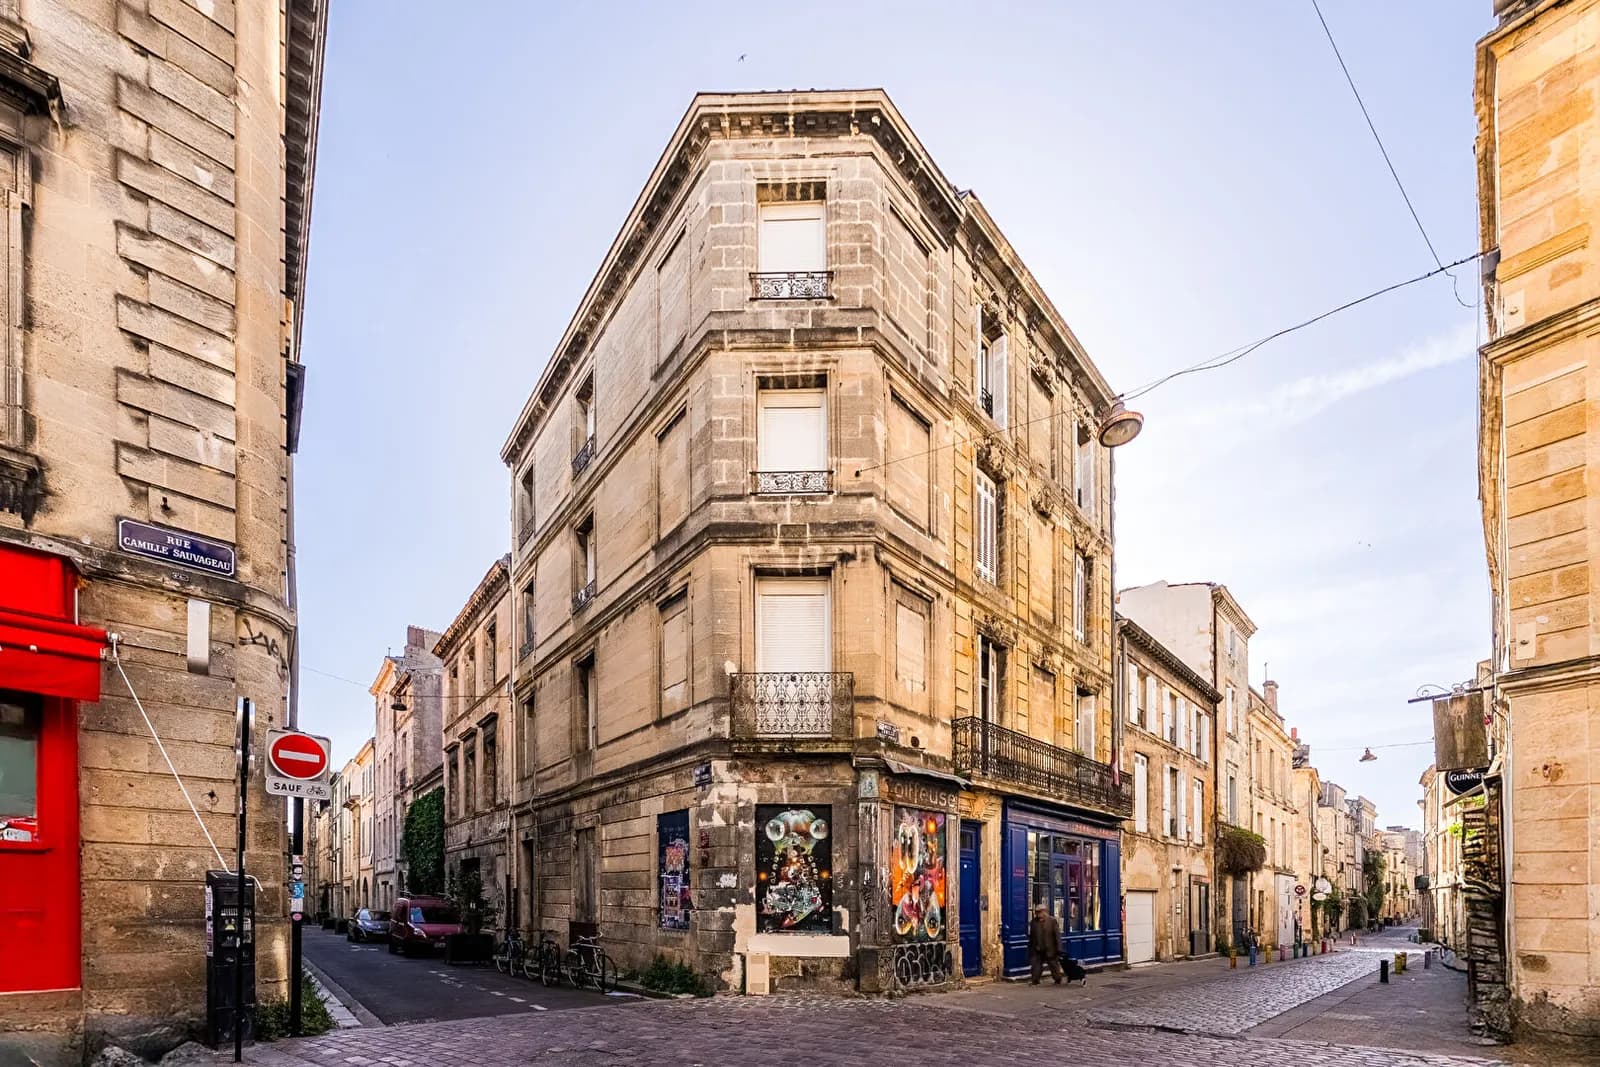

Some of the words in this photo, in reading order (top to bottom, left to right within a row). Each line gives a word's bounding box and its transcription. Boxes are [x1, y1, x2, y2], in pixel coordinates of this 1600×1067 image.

[166, 535, 191, 549] RUE
[123, 536, 168, 555] CAMILLE
[173, 548, 231, 571] SAUVAGEAU
[1450, 772, 1481, 782] GUINNE
[273, 782, 302, 793] SAUF
